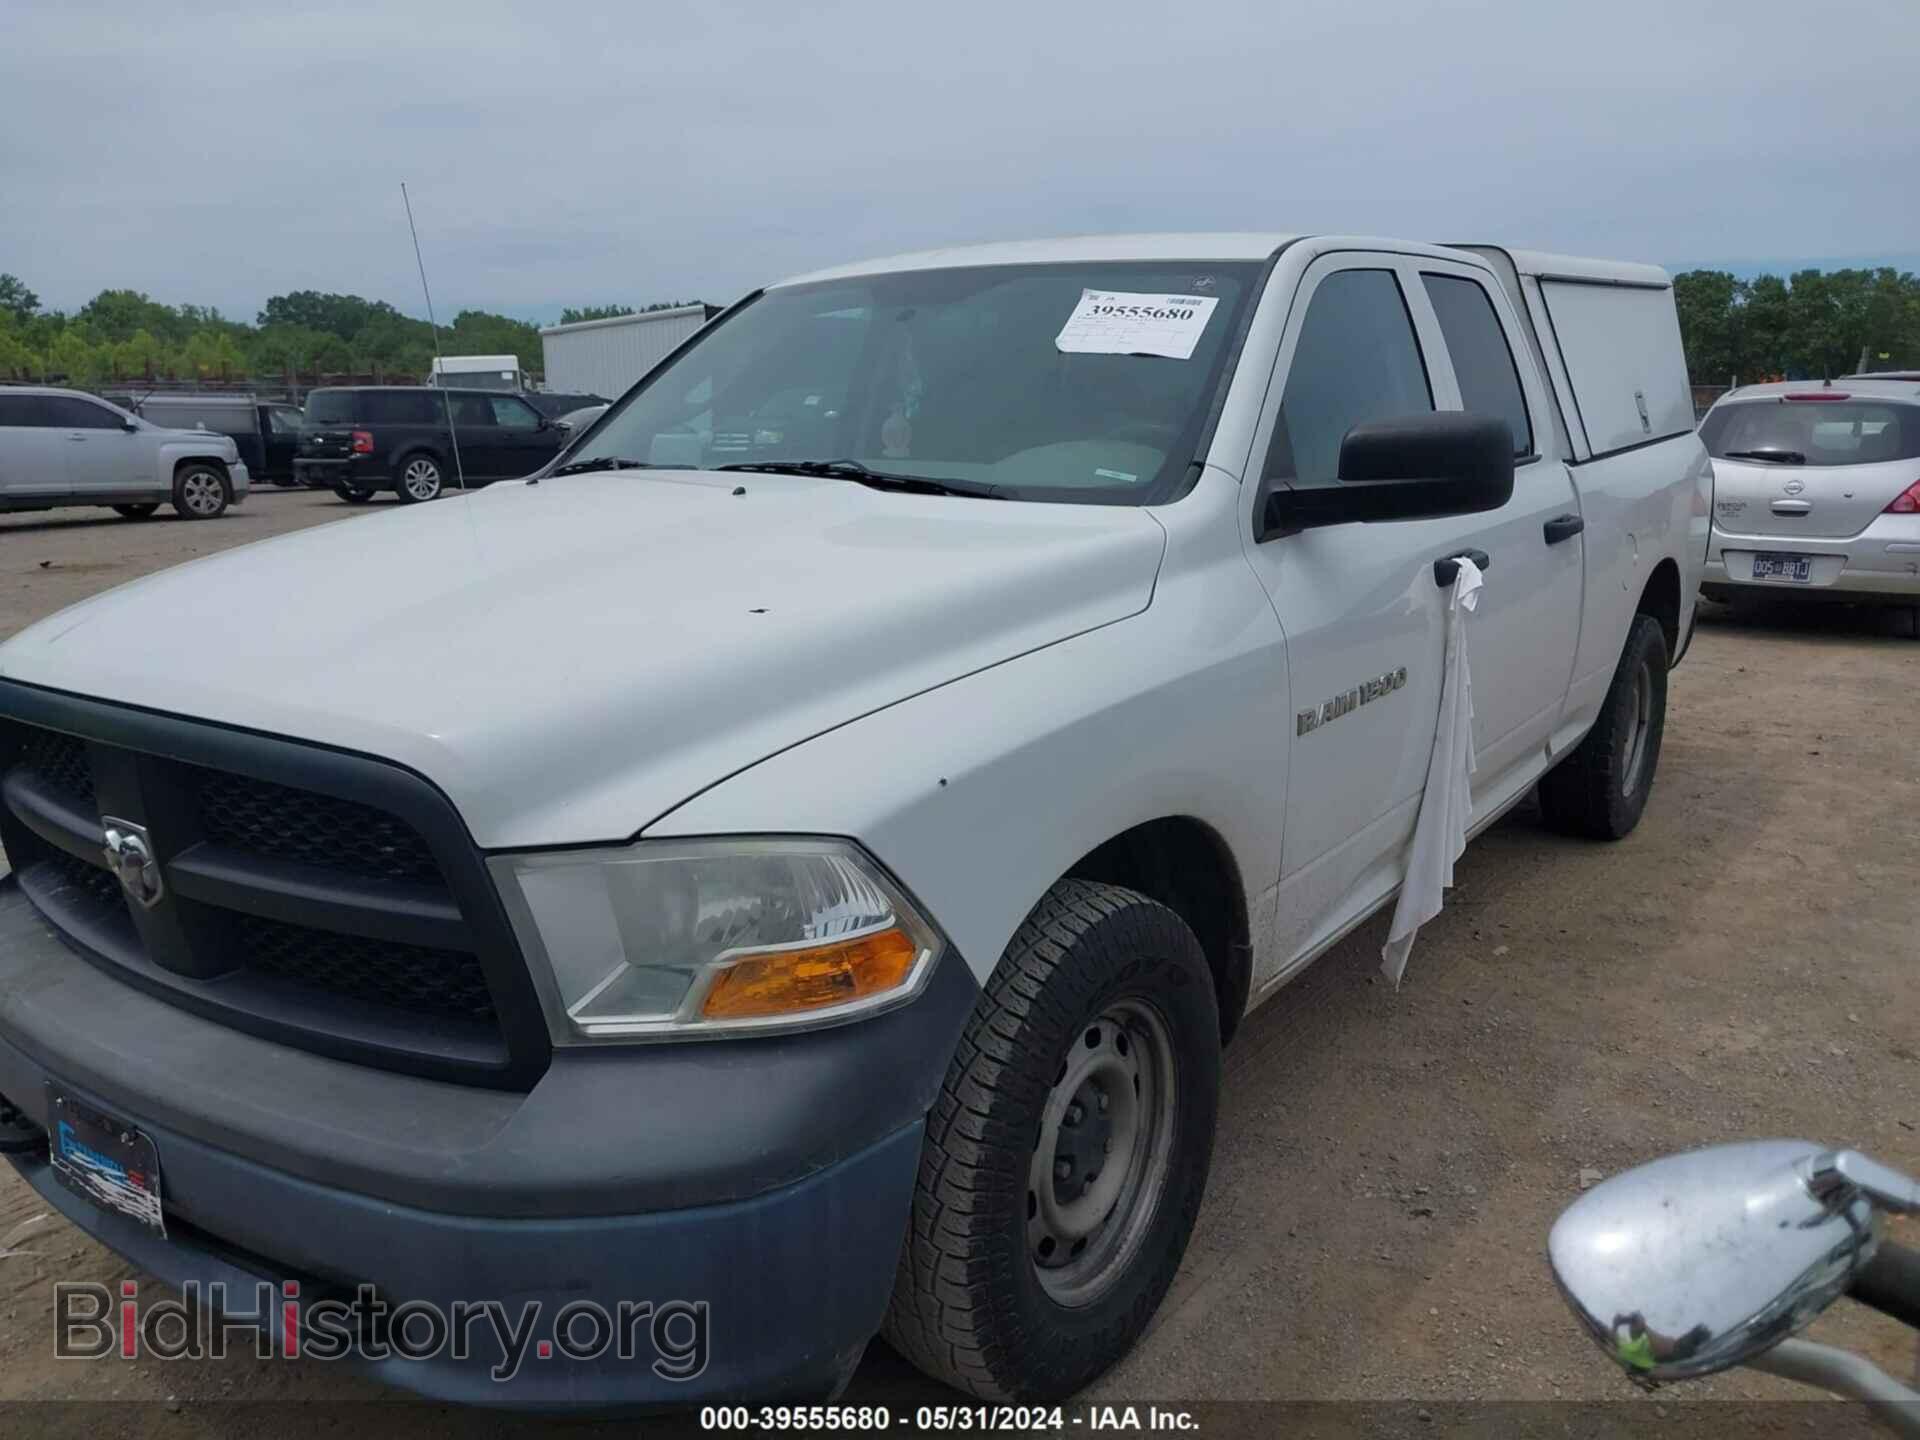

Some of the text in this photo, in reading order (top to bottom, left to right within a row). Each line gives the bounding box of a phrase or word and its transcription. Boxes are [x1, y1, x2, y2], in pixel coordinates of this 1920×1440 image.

[1085, 304, 1194, 321] 39555680
[1297, 666, 1407, 737] RAM 1500
